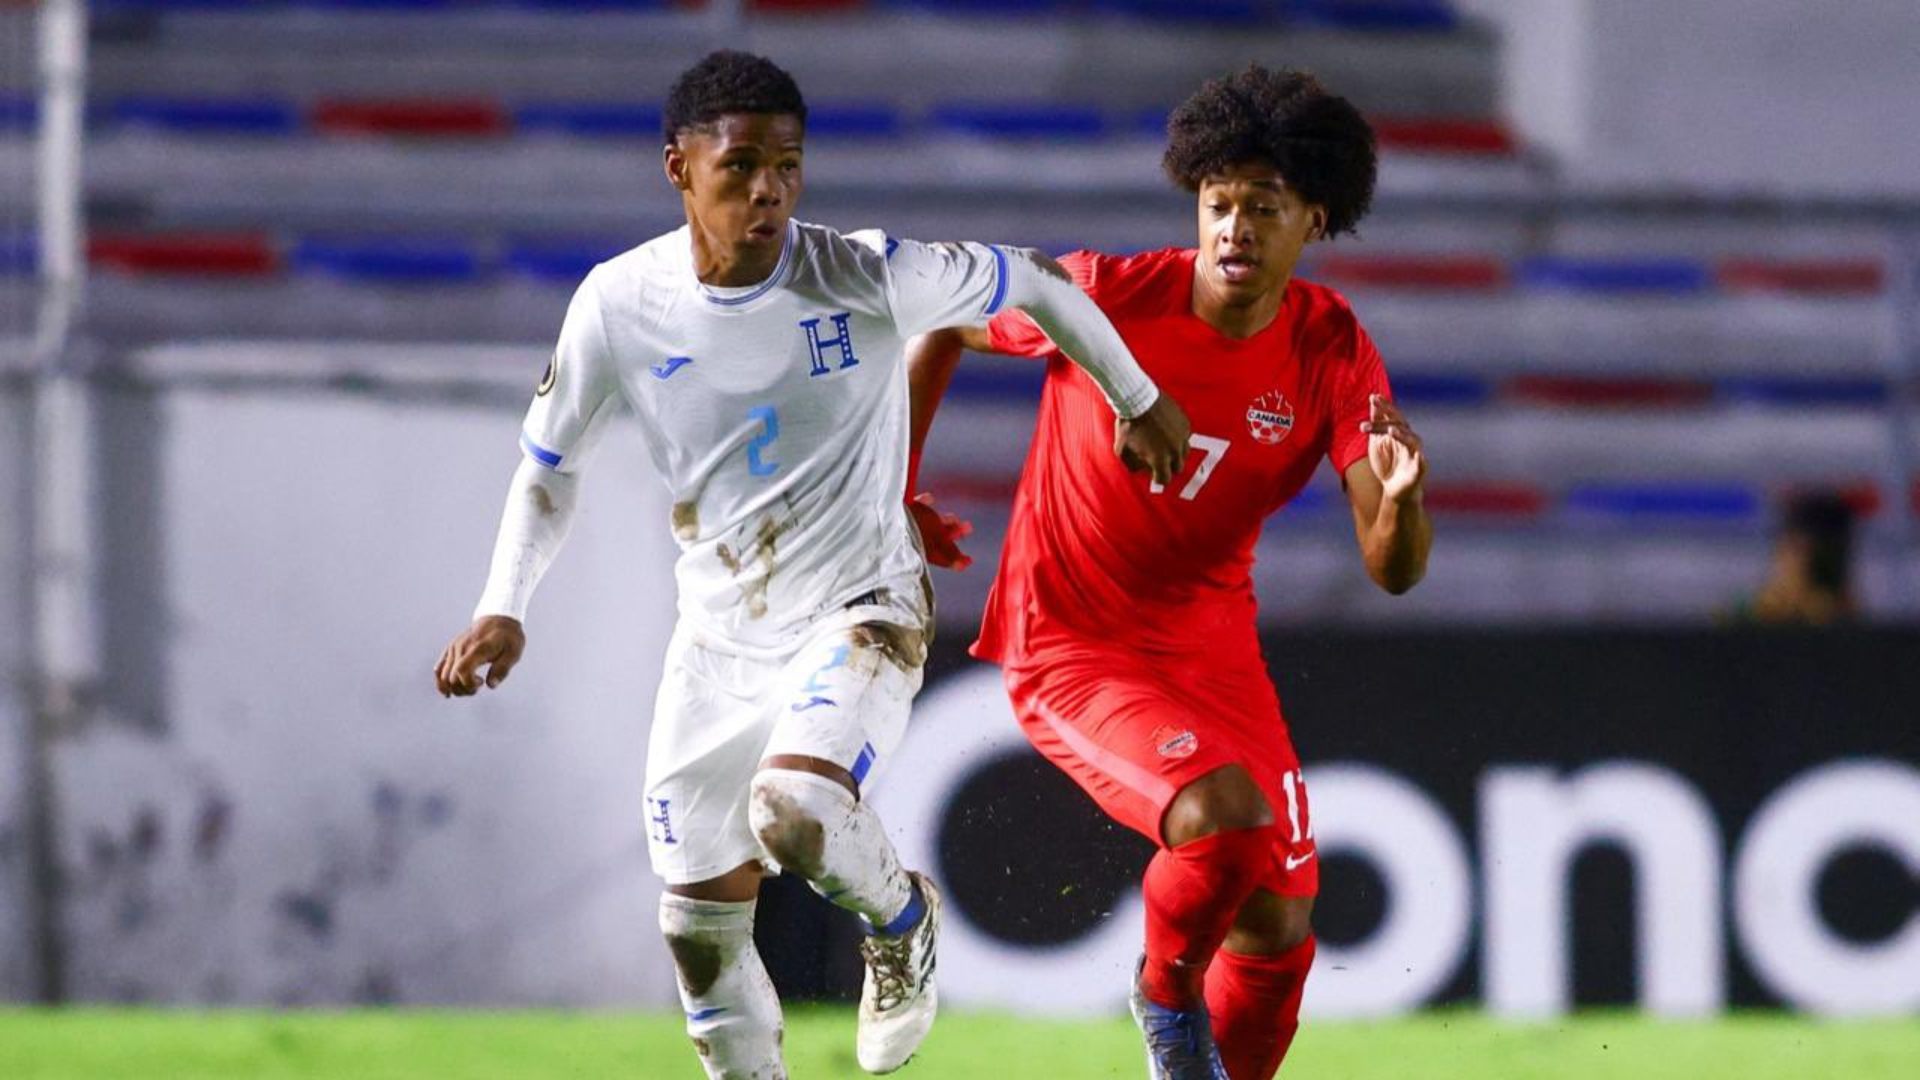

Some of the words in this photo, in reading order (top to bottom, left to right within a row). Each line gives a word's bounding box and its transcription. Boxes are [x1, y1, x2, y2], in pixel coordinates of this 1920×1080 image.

[800, 313, 859, 377] H
[747, 406, 780, 476] 2
[1248, 411, 1291, 427] CANADA
[1150, 432, 1232, 500] 7
